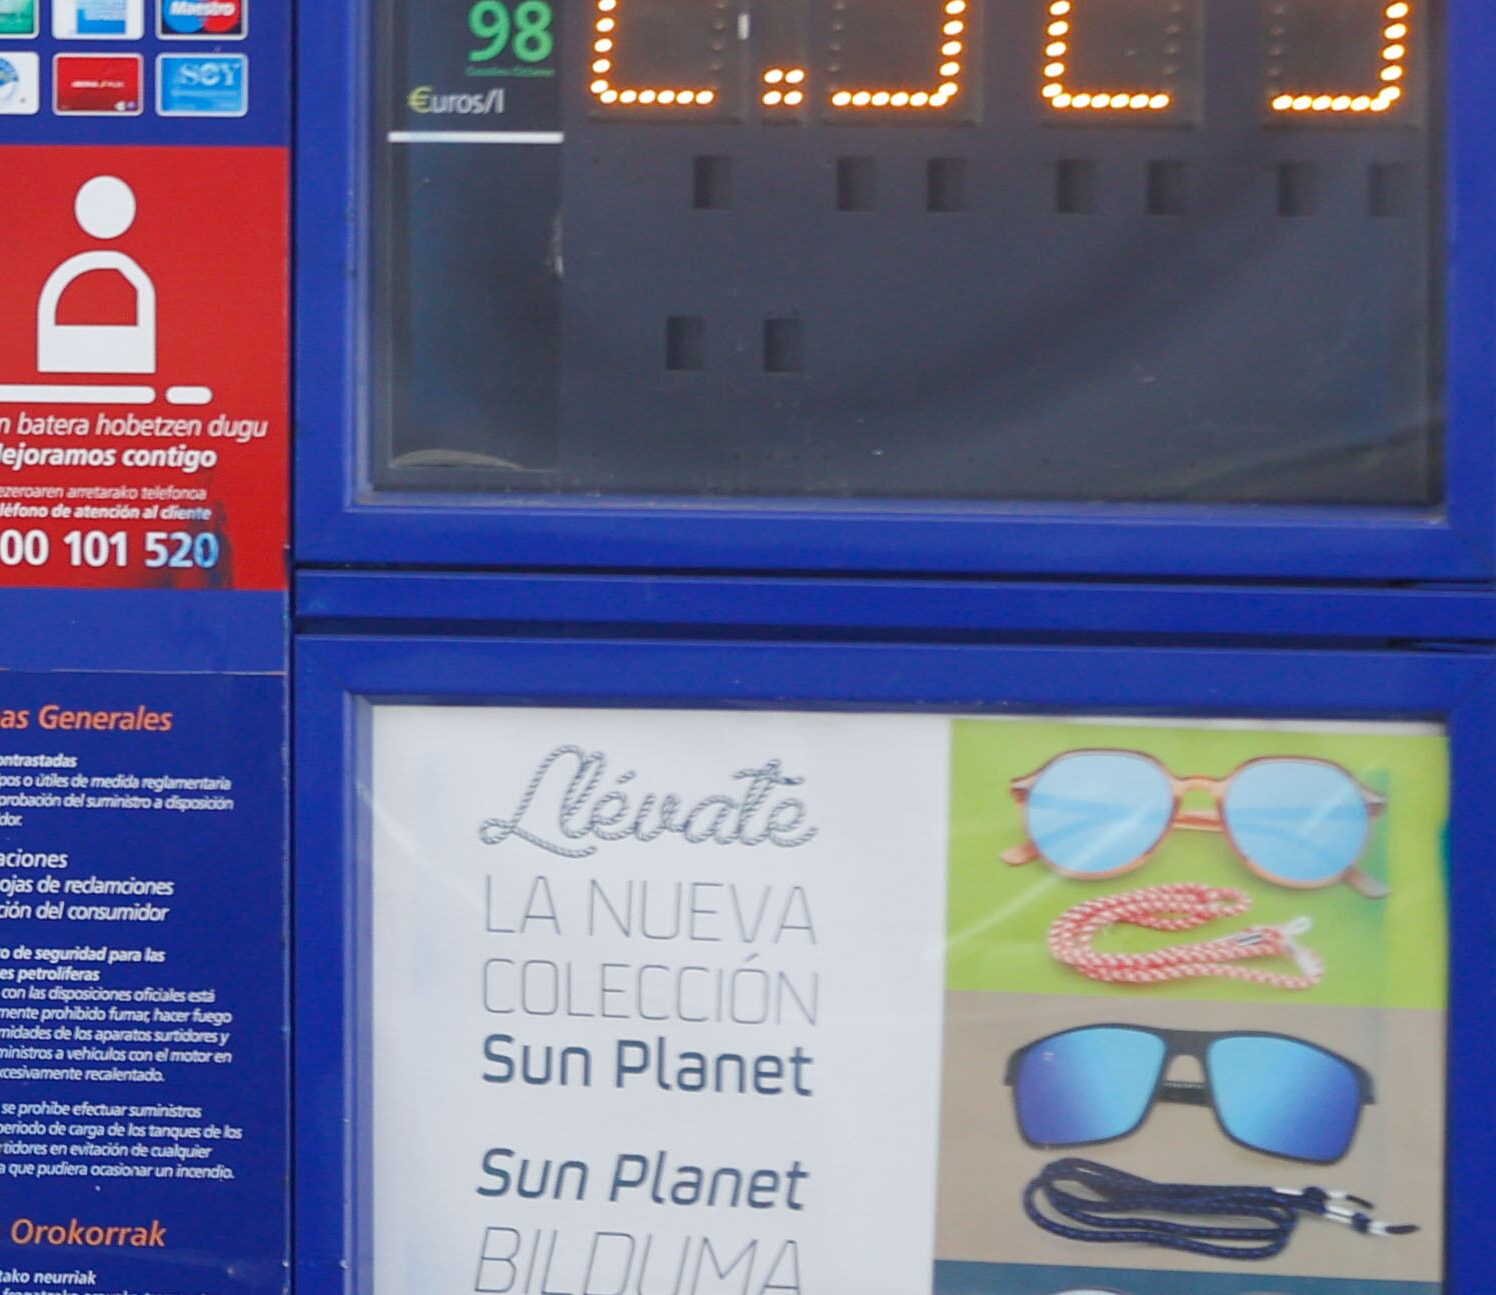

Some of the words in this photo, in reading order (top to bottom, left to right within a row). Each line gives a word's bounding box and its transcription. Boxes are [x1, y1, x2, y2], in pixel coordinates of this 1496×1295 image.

[169, 0, 236, 17] Maestro
[16, 411, 90, 435] batera
[94, 412, 202, 436] hobetzen
[207, 413, 268, 443] dugu
[121, 443, 217, 473] contigo
[65, 484, 138, 499] arretarako
[140, 484, 207, 500] telefonoa
[50, 502, 72, 518] de
[72, 504, 140, 519] atención
[141, 504, 159, 519] al
[159, 504, 212, 520] cliente
[63, 530, 126, 566] 101
[145, 531, 218, 568] 520
[37, 704, 173, 731] Generales
[476, 742, 819, 860] Llévate
[36, 874, 60, 893] de
[35, 900, 64, 919] del
[66, 902, 170, 921] consumidor
[483, 873, 561, 937] LA
[585, 879, 820, 948] NUEVA
[12, 944, 32, 959] de
[33, 945, 107, 963] seguridad
[107, 949, 142, 964] para
[143, 946, 166, 962] las
[0, 987, 26, 999] con
[27, 984, 46, 999] las
[47, 985, 132, 1003] disposiciones
[132, 986, 186, 1002] oficiales
[481, 952, 821, 1028] COLECCIÓN
[39, 1005, 106, 1022] prohibido
[152, 1007, 191, 1022] hacer
[191, 1007, 232, 1026] fuego
[52, 1025, 72, 1040] de
[73, 1025, 93, 1040] los
[93, 1028, 152, 1043] aparatos
[152, 1027, 218, 1043] surtidores
[127, 1050, 153, 1061] con
[154, 1047, 169, 1062] el
[169, 1049, 214, 1062] motor
[212, 1051, 232, 1063] en
[482, 1034, 592, 1089] Sun
[614, 1036, 815, 1098] Planet
[475, 1146, 589, 1206] Sun
[608, 1148, 808, 1212] Planet
[10, 1217, 166, 1247] Orokorrak
[473, 1225, 804, 1295] BILDUMA
[33, 1269, 96, 1284] neurriak
